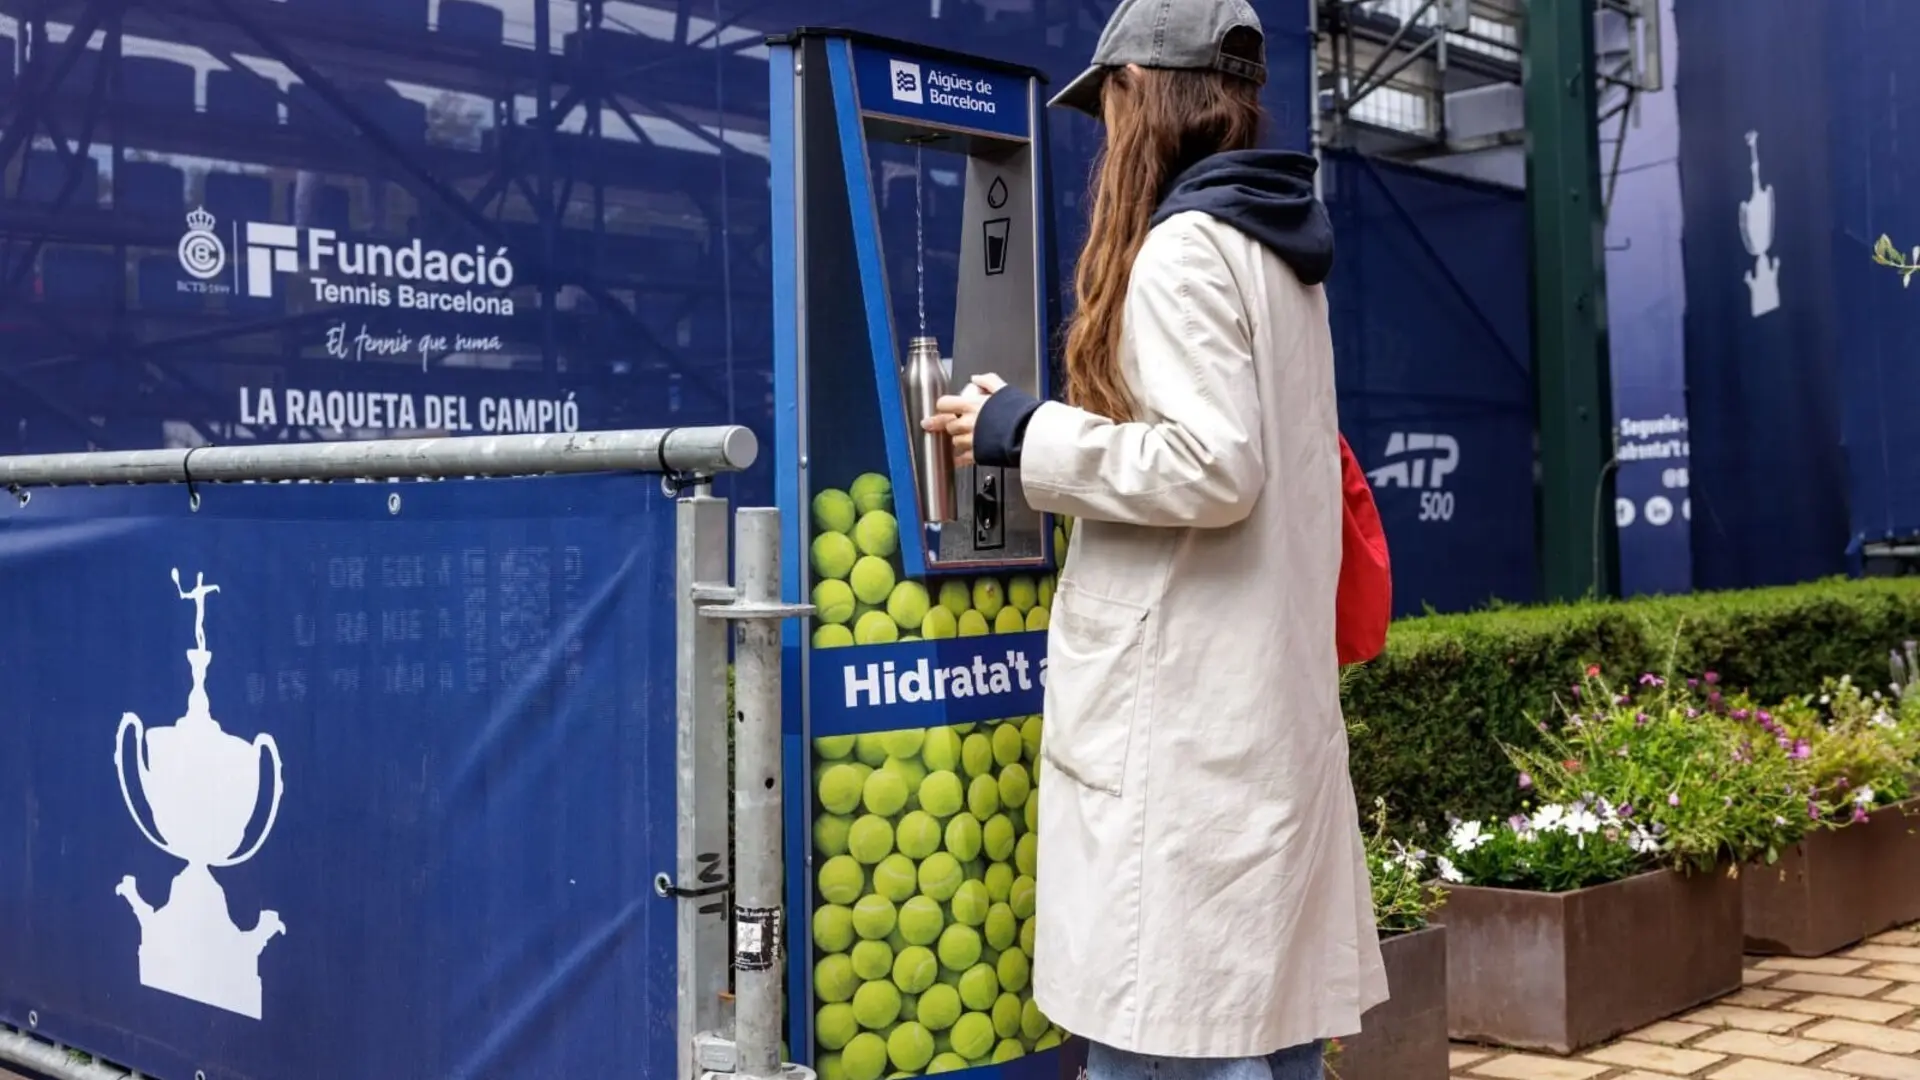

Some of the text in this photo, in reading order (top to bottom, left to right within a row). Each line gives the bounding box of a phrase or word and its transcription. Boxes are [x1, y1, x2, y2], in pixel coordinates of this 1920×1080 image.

[928, 70, 993, 95] Aigües de
[929, 88, 996, 114] Barcelona
[308, 228, 514, 288] Fundació
[310, 277, 514, 316] Tennis Barcelona
[325, 322, 504, 373] El tennis que suma
[239, 386, 580, 433] LA RAQUETA DEL CAMPIÓ
[1366, 431, 1460, 489] ATP
[1418, 491, 1455, 521] 500
[843, 650, 1033, 708] Hidrata't
